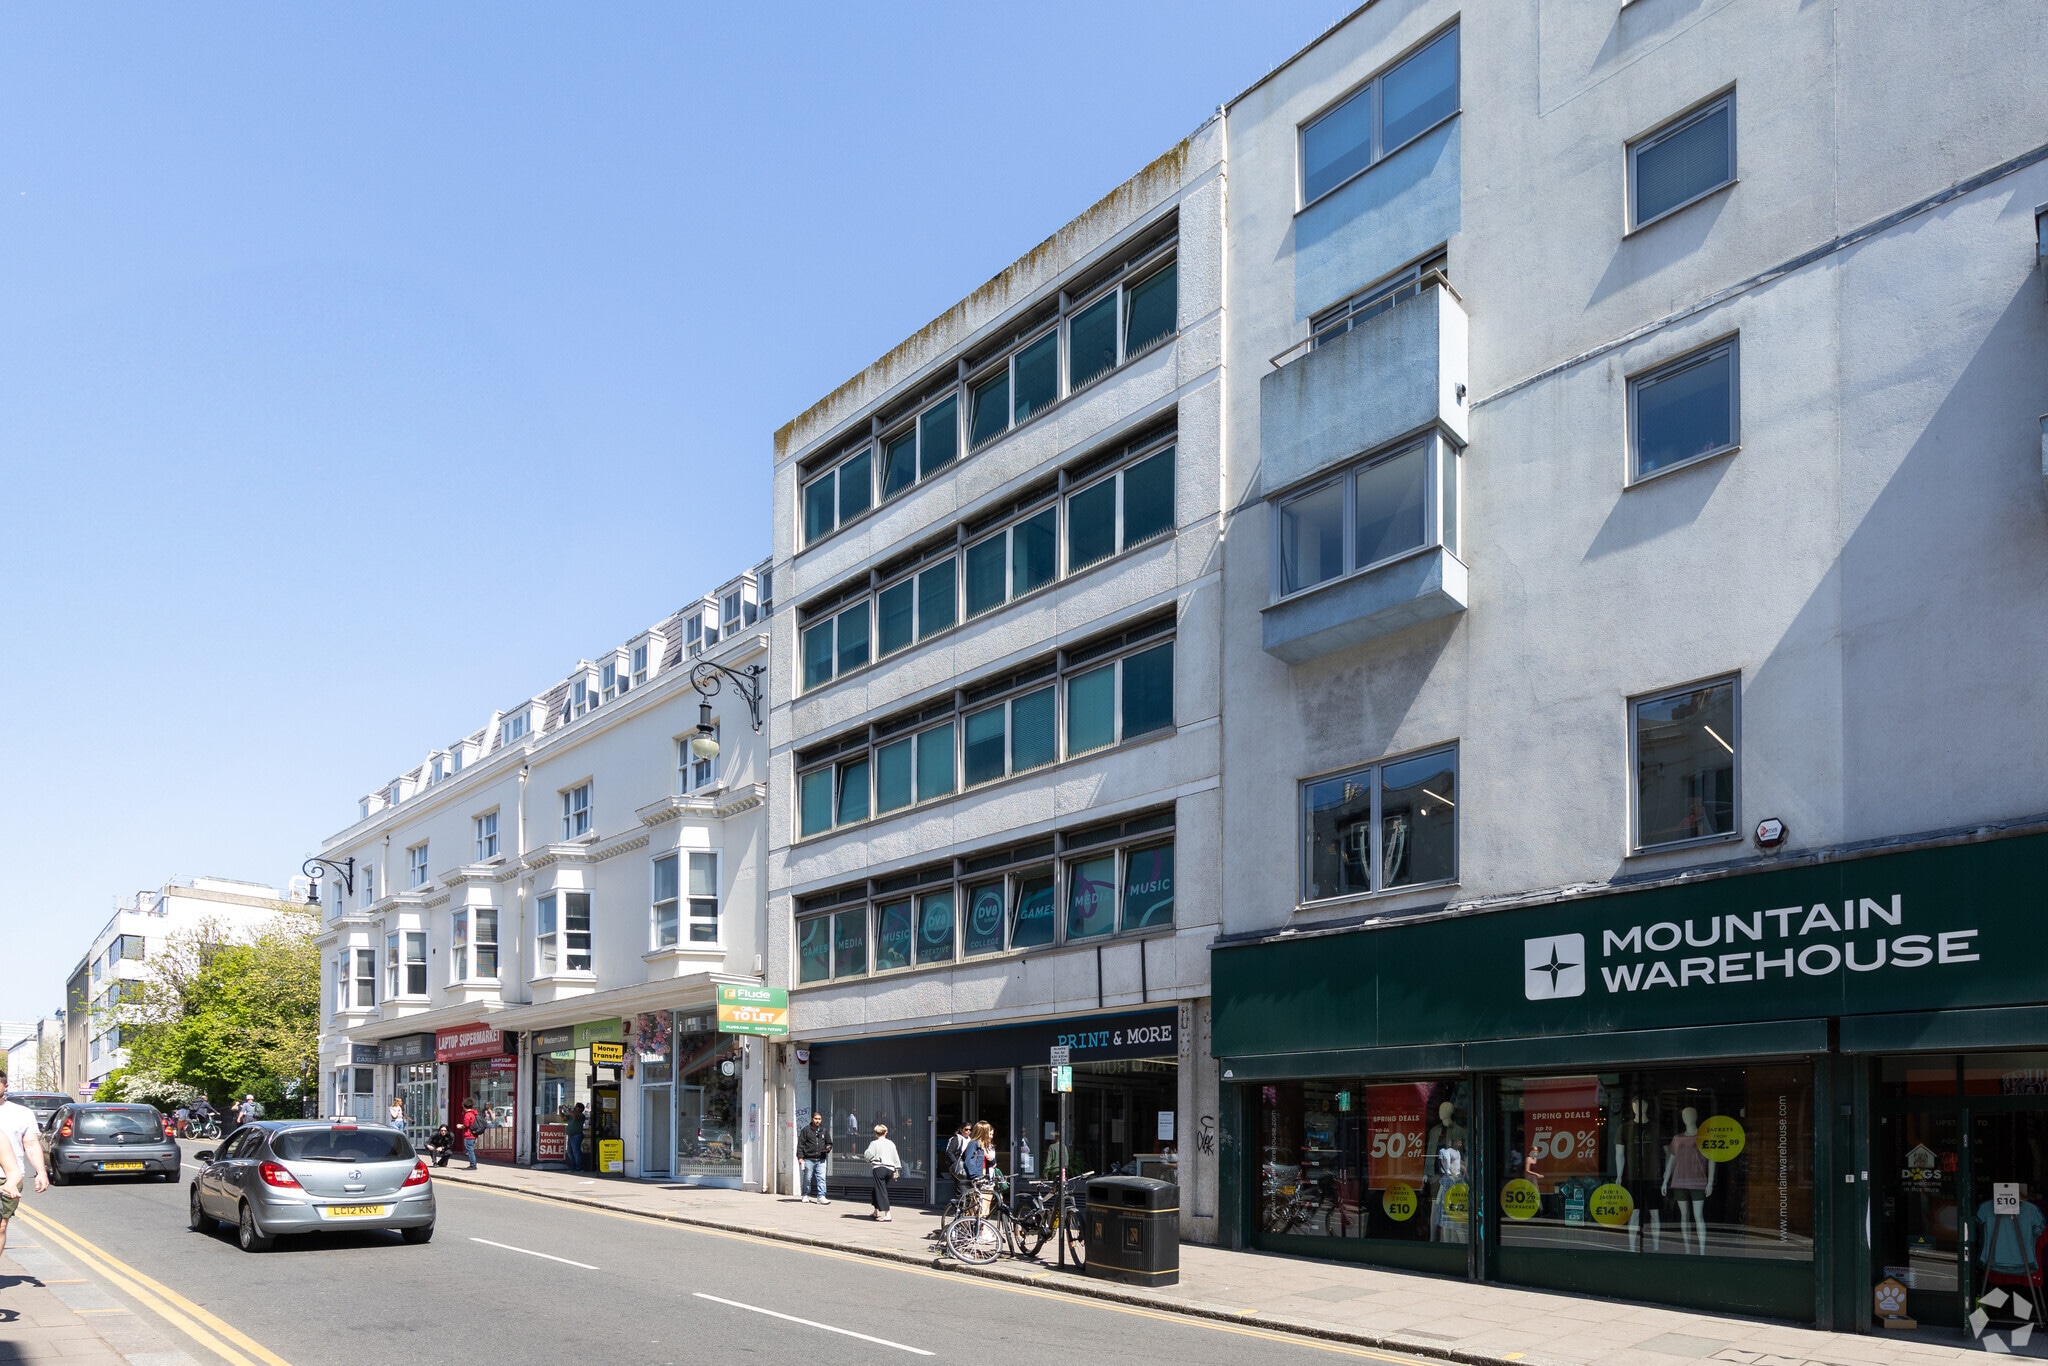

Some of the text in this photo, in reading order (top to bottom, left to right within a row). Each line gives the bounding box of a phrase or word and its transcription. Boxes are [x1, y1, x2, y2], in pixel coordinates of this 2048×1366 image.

[1130, 878, 1171, 897] MUSIC
[1074, 891, 1111, 908] MEDIA
[978, 905, 998, 919] DV8
[928, 914, 947, 928] DV8
[1603, 894, 1901, 957] MOUNTAIN
[882, 929, 910, 942] MUSIC
[838, 937, 863, 950] MEDIA
[970, 937, 1000, 949] COLLEGE
[802, 943, 829, 957] GAMES
[920, 945, 950, 957] CREATIVE
[1600, 929, 1980, 993] WAREHOUSE
[737, 989, 771, 999] Flude
[740, 1005, 761, 1013] Office
[732, 1010, 775, 1023] TO LET
[438, 1029, 500, 1051] LAPTOP SUPERMARKET
[1057, 1025, 1172, 1049] PRINT & MORE
[597, 1045, 619, 1053] Money
[1532, 1111, 1591, 1120] SPRING DEALS
[540, 1145, 565, 1155] SALE
[1701, 1139, 1740, 1150] £32.99
[1407, 1149, 1422, 1158] off
[1577, 1149, 1595, 1158] off
[1778, 1095, 1788, 1243] www.mountainwarehouse.com
[1996, 1197, 2017, 1205] £10
[333, 1206, 378, 1215] LC12 KNY
[1389, 1203, 1411, 1214] £10
[1595, 1206, 1628, 1216] £14.99
